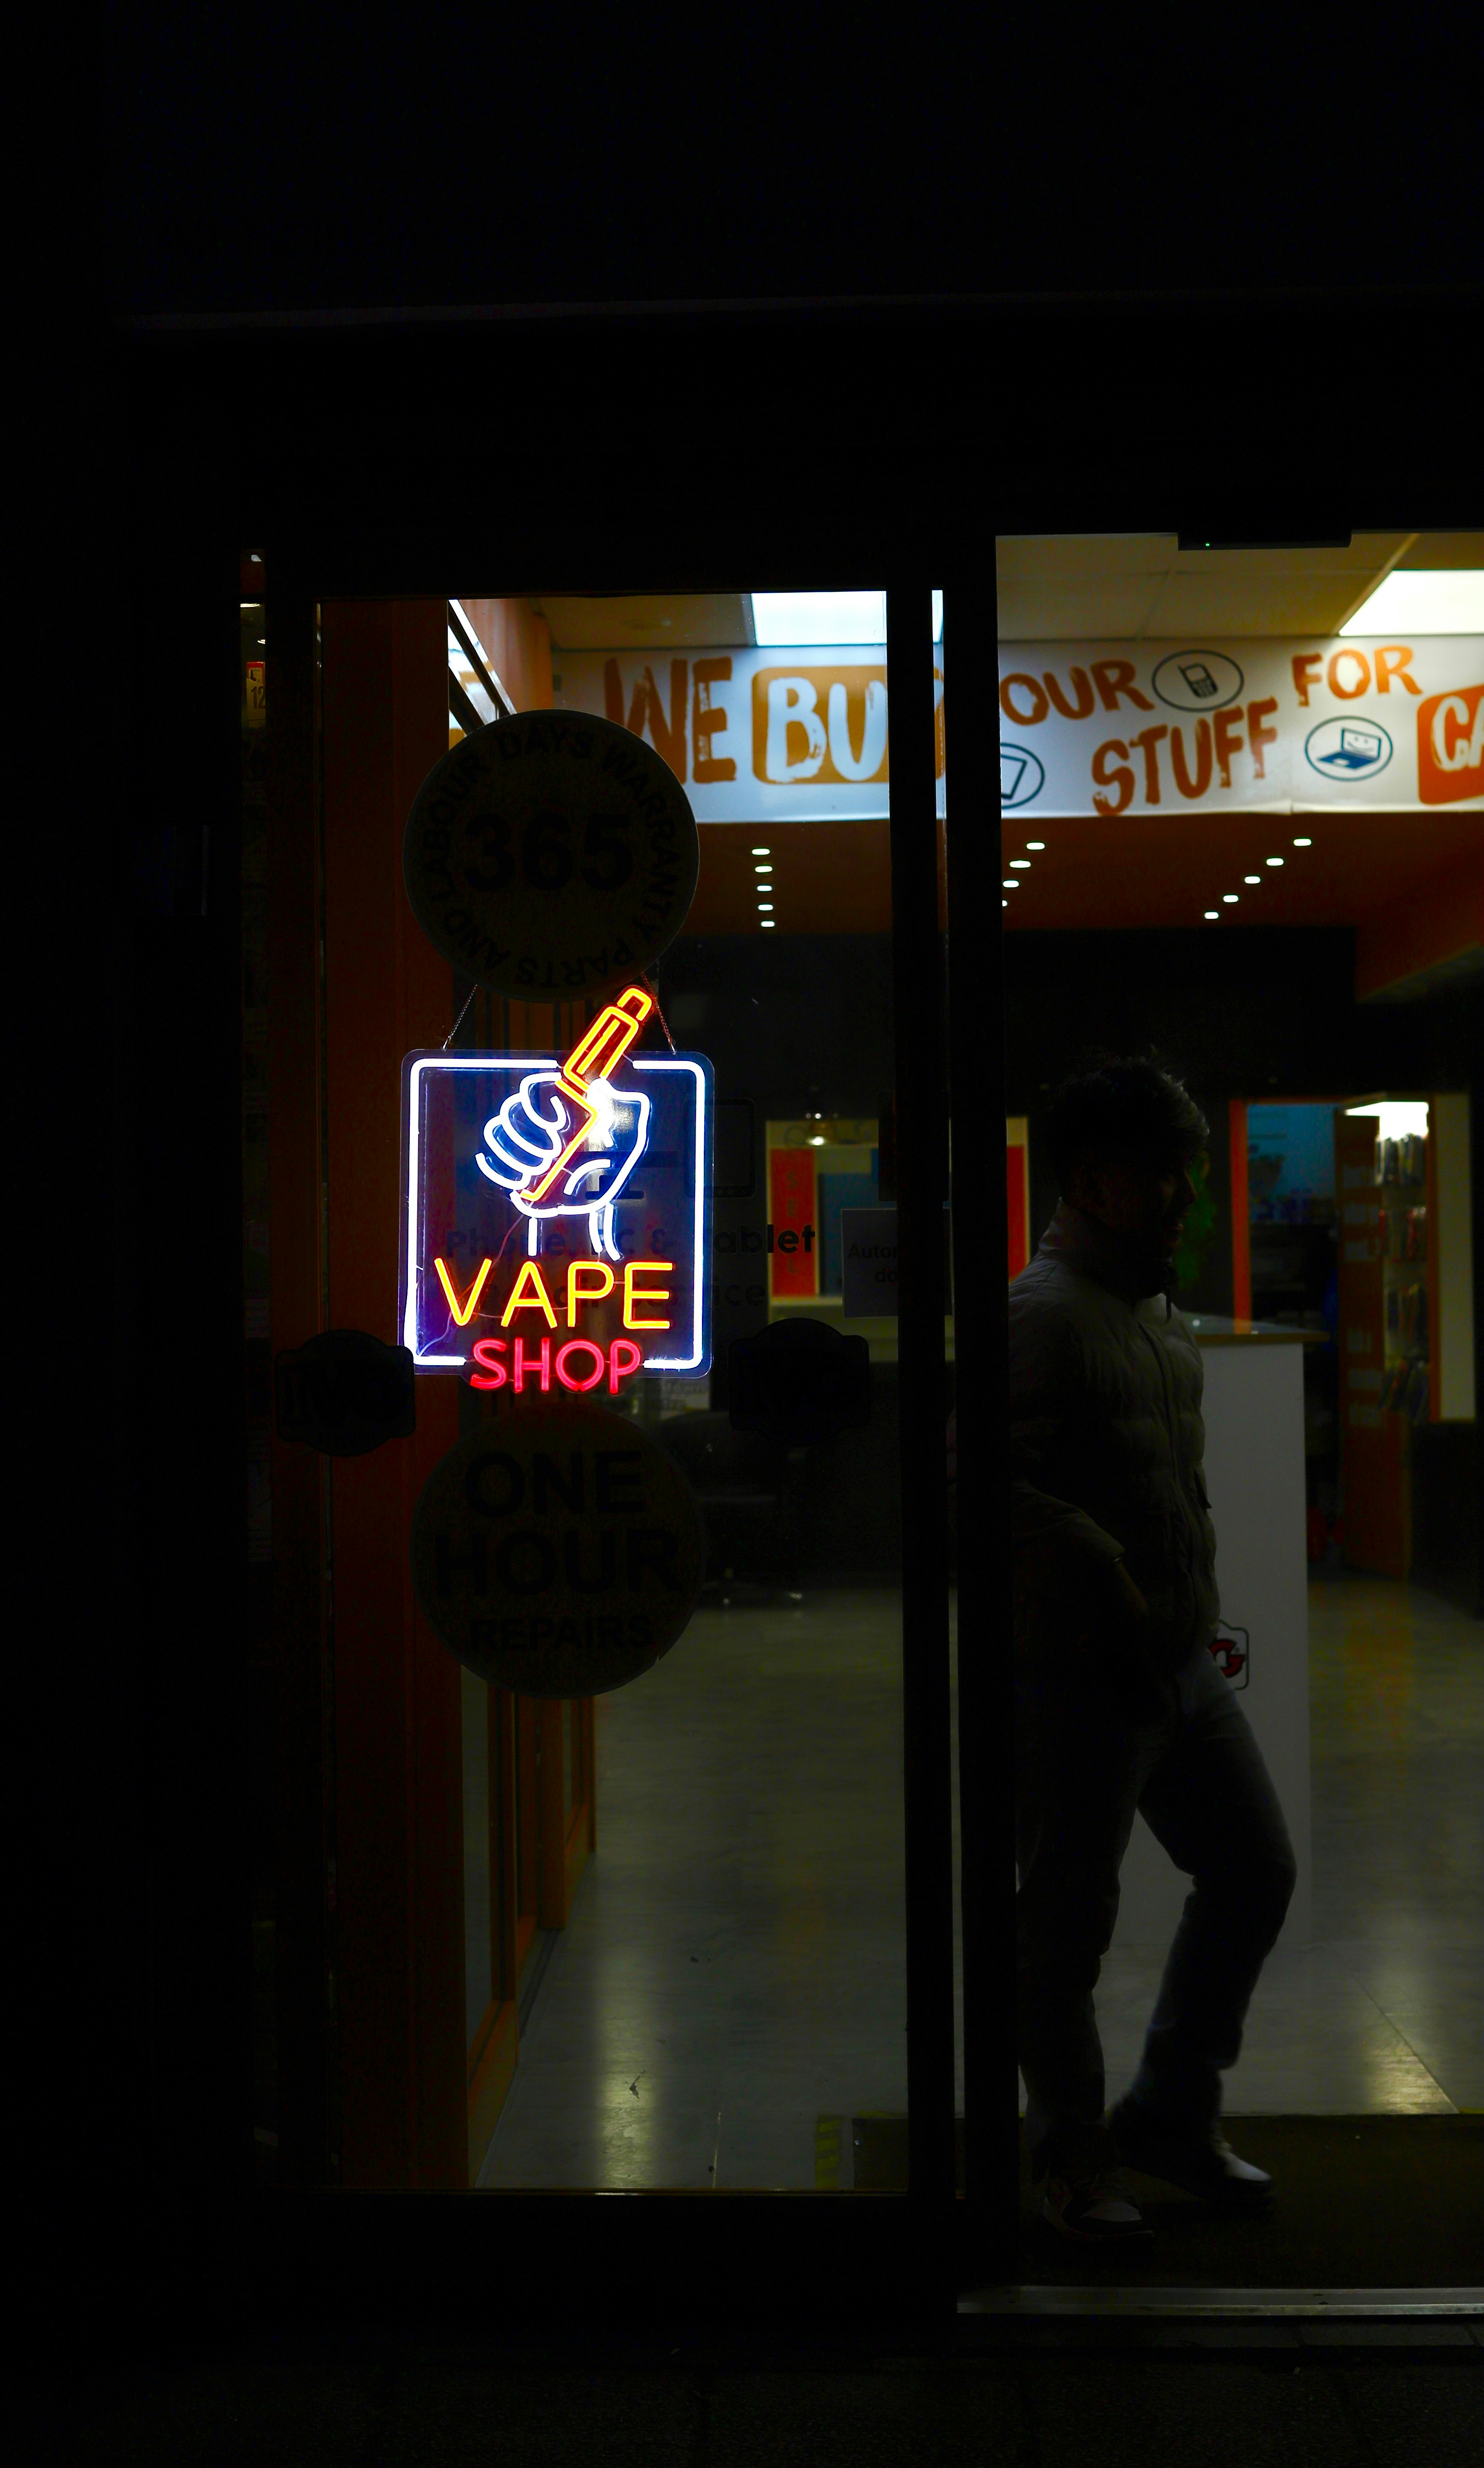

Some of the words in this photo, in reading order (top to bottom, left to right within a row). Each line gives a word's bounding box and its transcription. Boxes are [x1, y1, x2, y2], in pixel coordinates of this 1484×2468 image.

[495, 725, 594, 760] DAYS
[604, 658, 735, 784] WE
[765, 677, 944, 783] BU
[1000, 660, 1154, 725] OUR
[1292, 647, 1422, 707] FOR
[1092, 698, 1277, 817] STUFF
[423, 752, 492, 902] LABOUR
[463, 813, 633, 891] 365
[601, 743, 681, 943] WARRANTY
[443, 909, 511, 971] AND
[515, 937, 636, 988] PARTS
[698, 1224, 815, 1254] ablet
[433, 1257, 675, 1330] VAPE
[469, 1336, 642, 1395] SHOP
[466, 1450, 644, 1517] ONE
[436, 1529, 682, 1598] HOUR
[469, 1615, 654, 1651] REPAIRS
